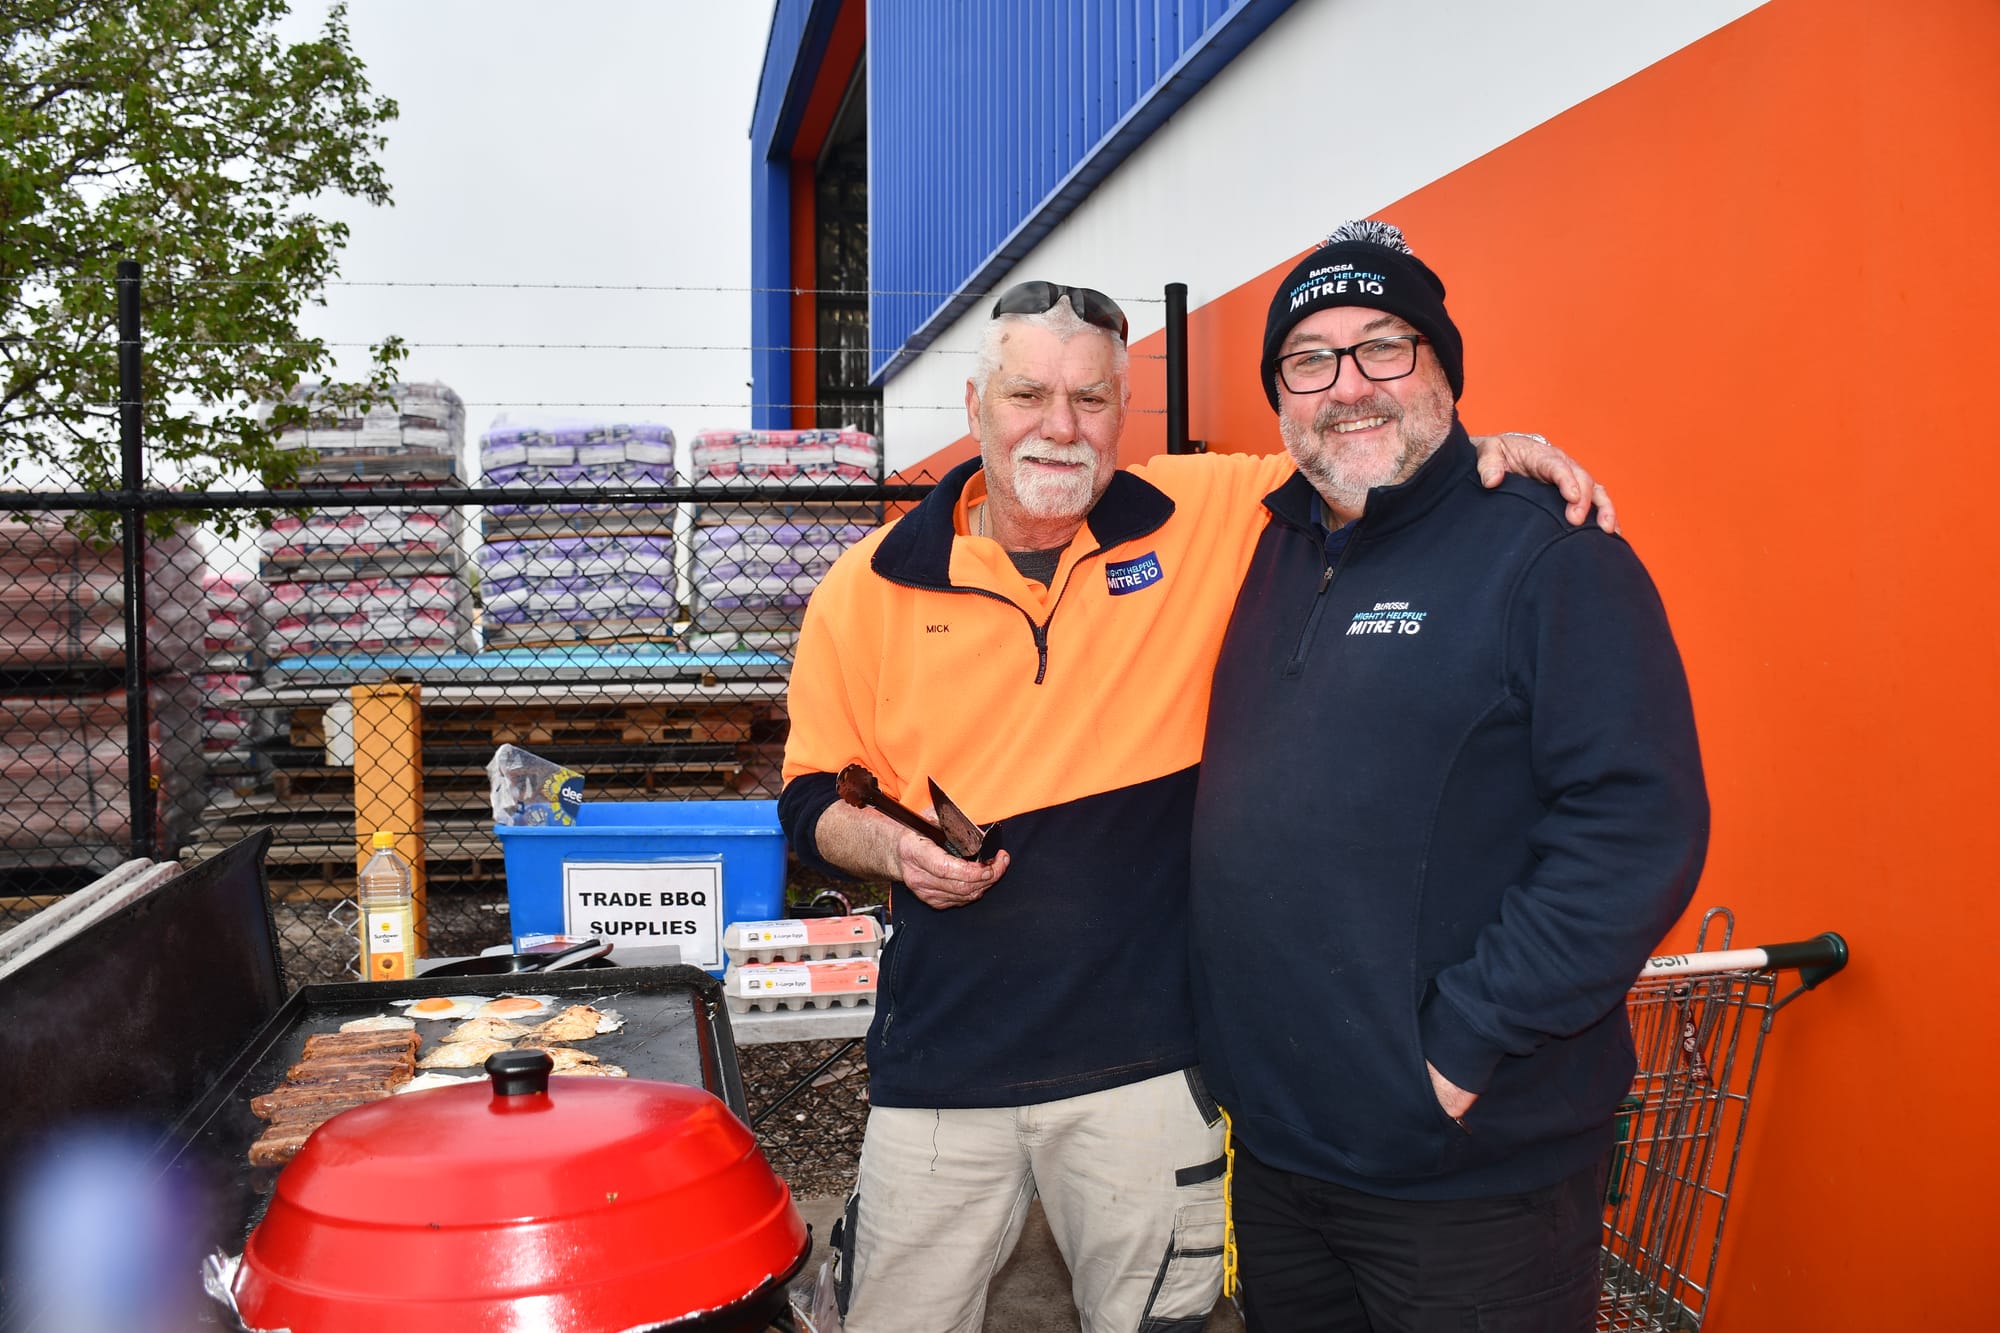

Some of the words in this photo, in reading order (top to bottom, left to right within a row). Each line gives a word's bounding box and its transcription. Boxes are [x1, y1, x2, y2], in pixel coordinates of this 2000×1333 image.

[1309, 264, 1353, 278] BAROSSA
[1290, 275, 1328, 298] MIGHTY
[1334, 272, 1382, 282] HELPFUL
[1290, 280, 1348, 312] MITRE
[1358, 280, 1384, 295] 10
[1107, 568, 1126, 577] IGHTY
[1127, 559, 1156, 574] HELPFUL
[1107, 573, 1142, 589] MITRE
[1141, 567, 1158, 581] 10
[1373, 602, 1409, 611] BAROSSA
[1352, 611, 1385, 621] MIGHTY
[1386, 611, 1423, 621] HELPFUL
[926, 624, 950, 634] MICK
[1345, 620, 1396, 635] MITRE
[1397, 620, 1420, 635] 10
[579, 892, 652, 907] TRADE
[660, 891, 706, 907] BBQ
[590, 920, 697, 936] SUPPLIES
